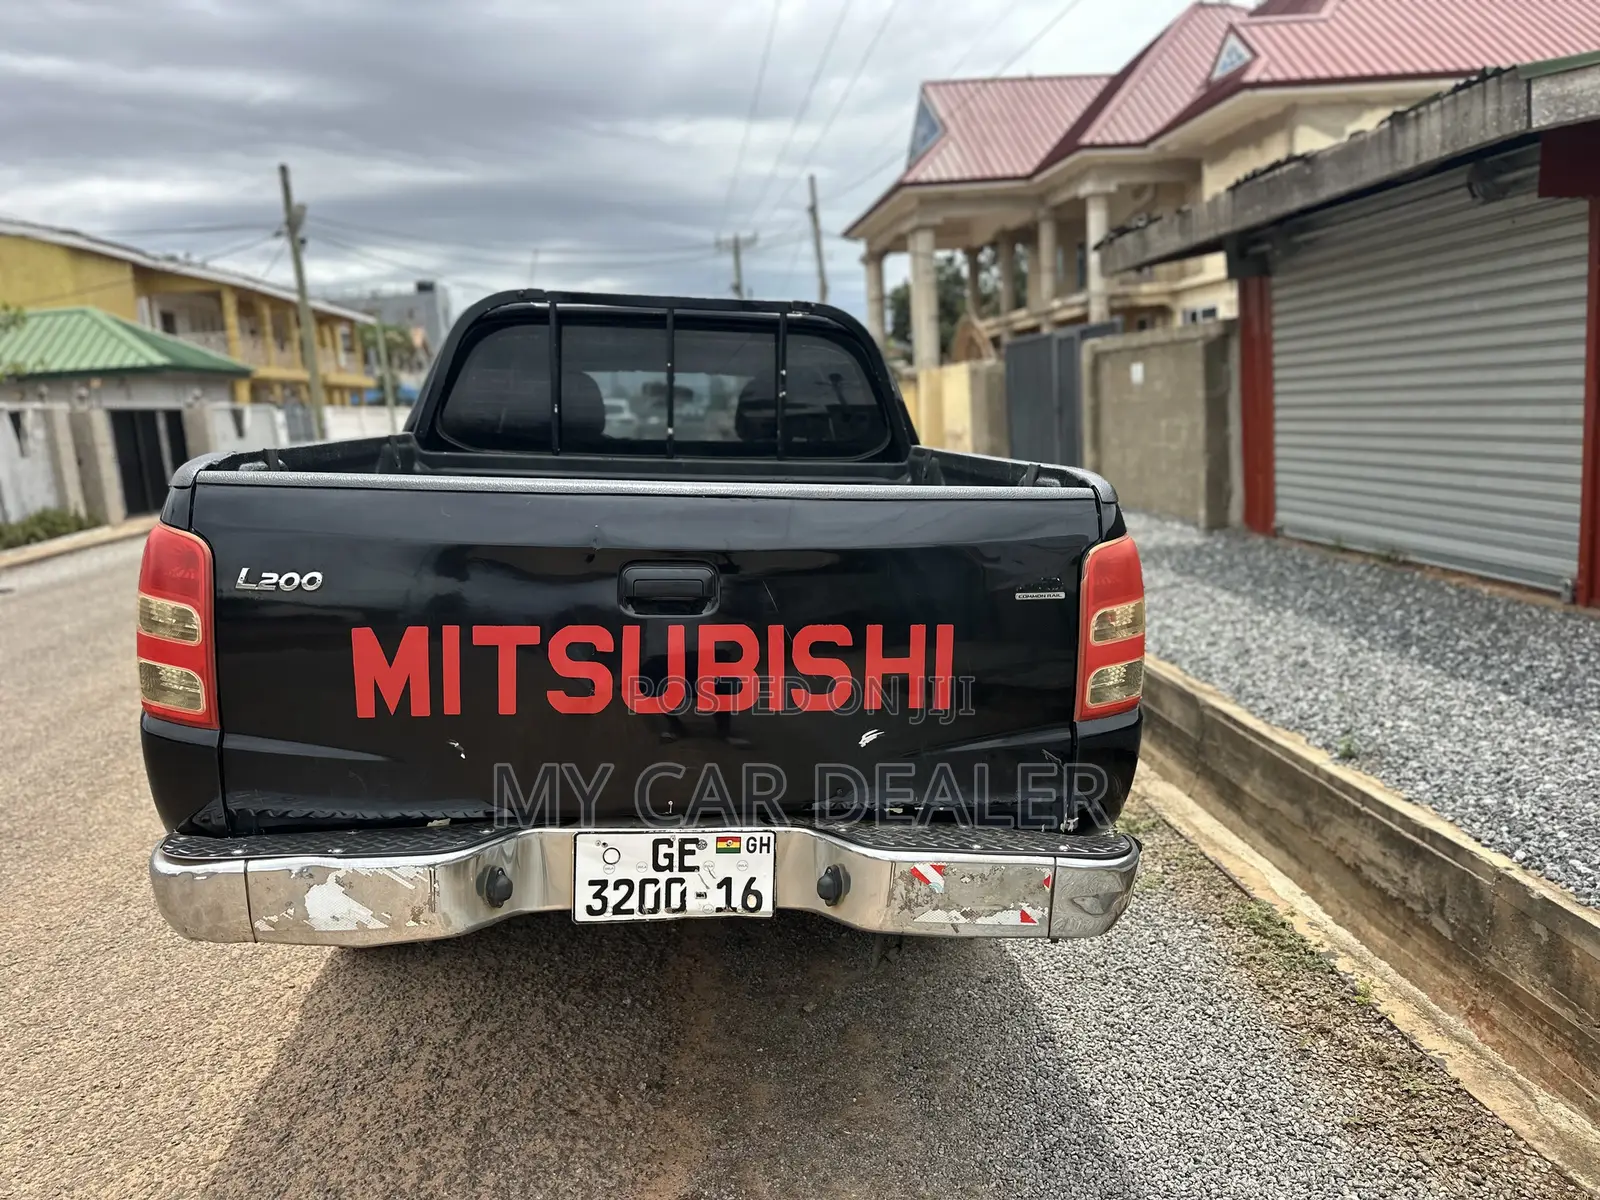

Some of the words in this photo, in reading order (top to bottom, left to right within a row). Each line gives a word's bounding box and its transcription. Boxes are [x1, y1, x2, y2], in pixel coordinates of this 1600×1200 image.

[235, 567, 323, 592] L200
[351, 624, 954, 718] MITSUBISHI
[652, 838, 700, 873] GE
[746, 836, 771, 854] GH
